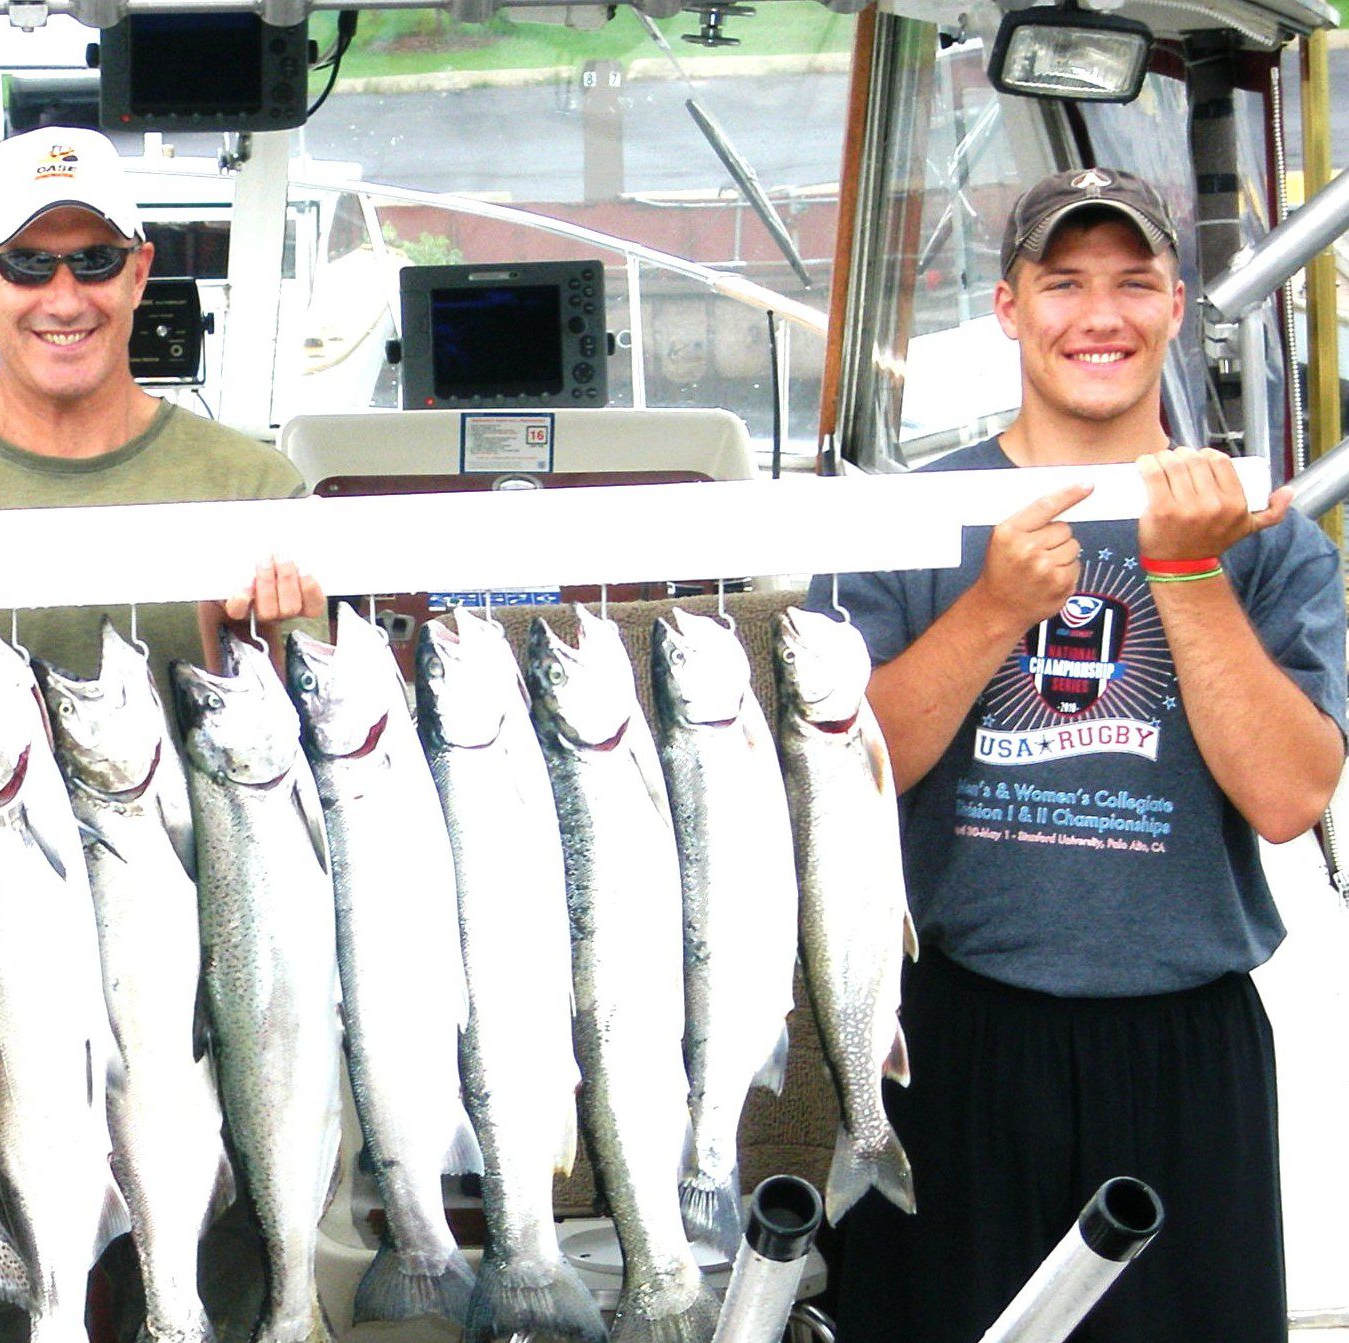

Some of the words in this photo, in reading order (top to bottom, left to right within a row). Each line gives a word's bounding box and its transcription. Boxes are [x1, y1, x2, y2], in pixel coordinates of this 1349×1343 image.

[529, 430, 544, 441] 16
[1029, 656, 1115, 680] CHAMPIONSHIP
[979, 735, 1033, 758] USA
[1058, 725, 1154, 751] RUGBY
[995, 781, 1010, 800] &
[1013, 782, 1090, 806] Women's
[1094, 789, 1174, 815] Collegiate
[1007, 804, 1014, 822] I
[1017, 805, 1032, 823] &
[1051, 807, 1172, 838] Championships
[1151, 842, 1166, 854] CA
